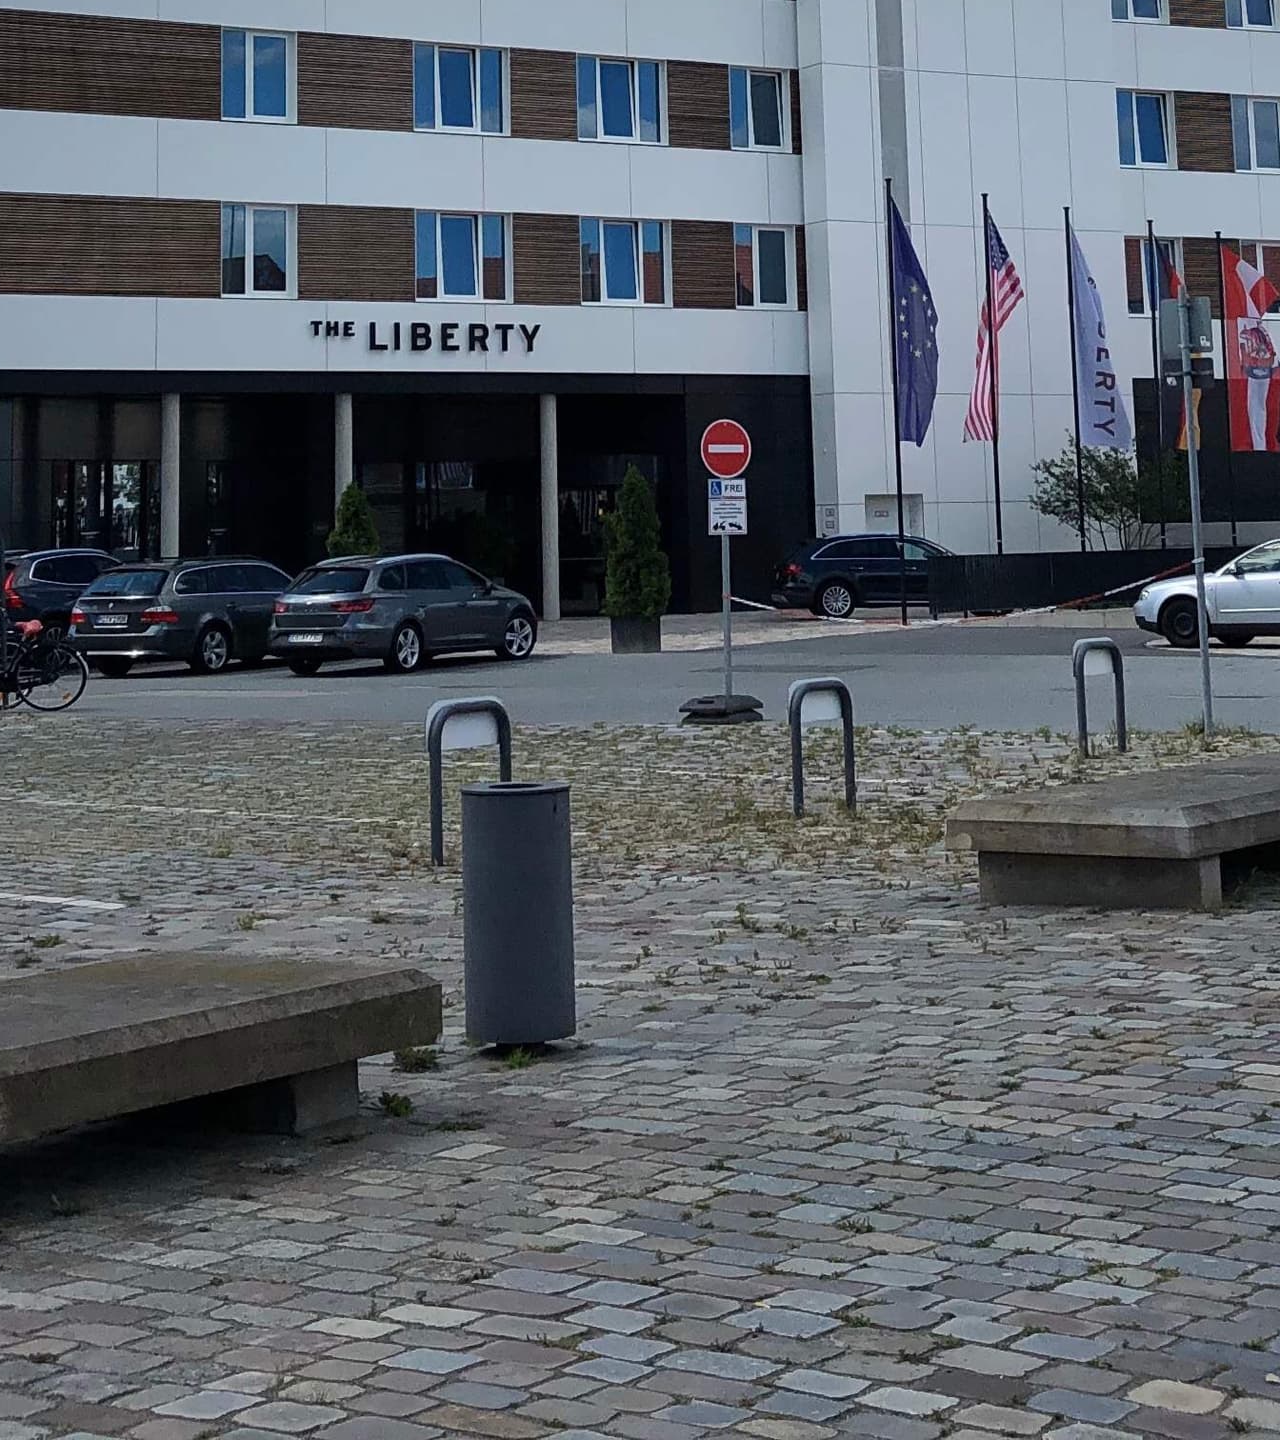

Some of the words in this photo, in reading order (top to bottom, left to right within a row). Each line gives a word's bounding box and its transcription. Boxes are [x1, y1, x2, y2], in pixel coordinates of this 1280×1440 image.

[310, 320, 355, 337] THE
[369, 321, 541, 352] LIBERTY
[724, 484, 743, 493] FREI
